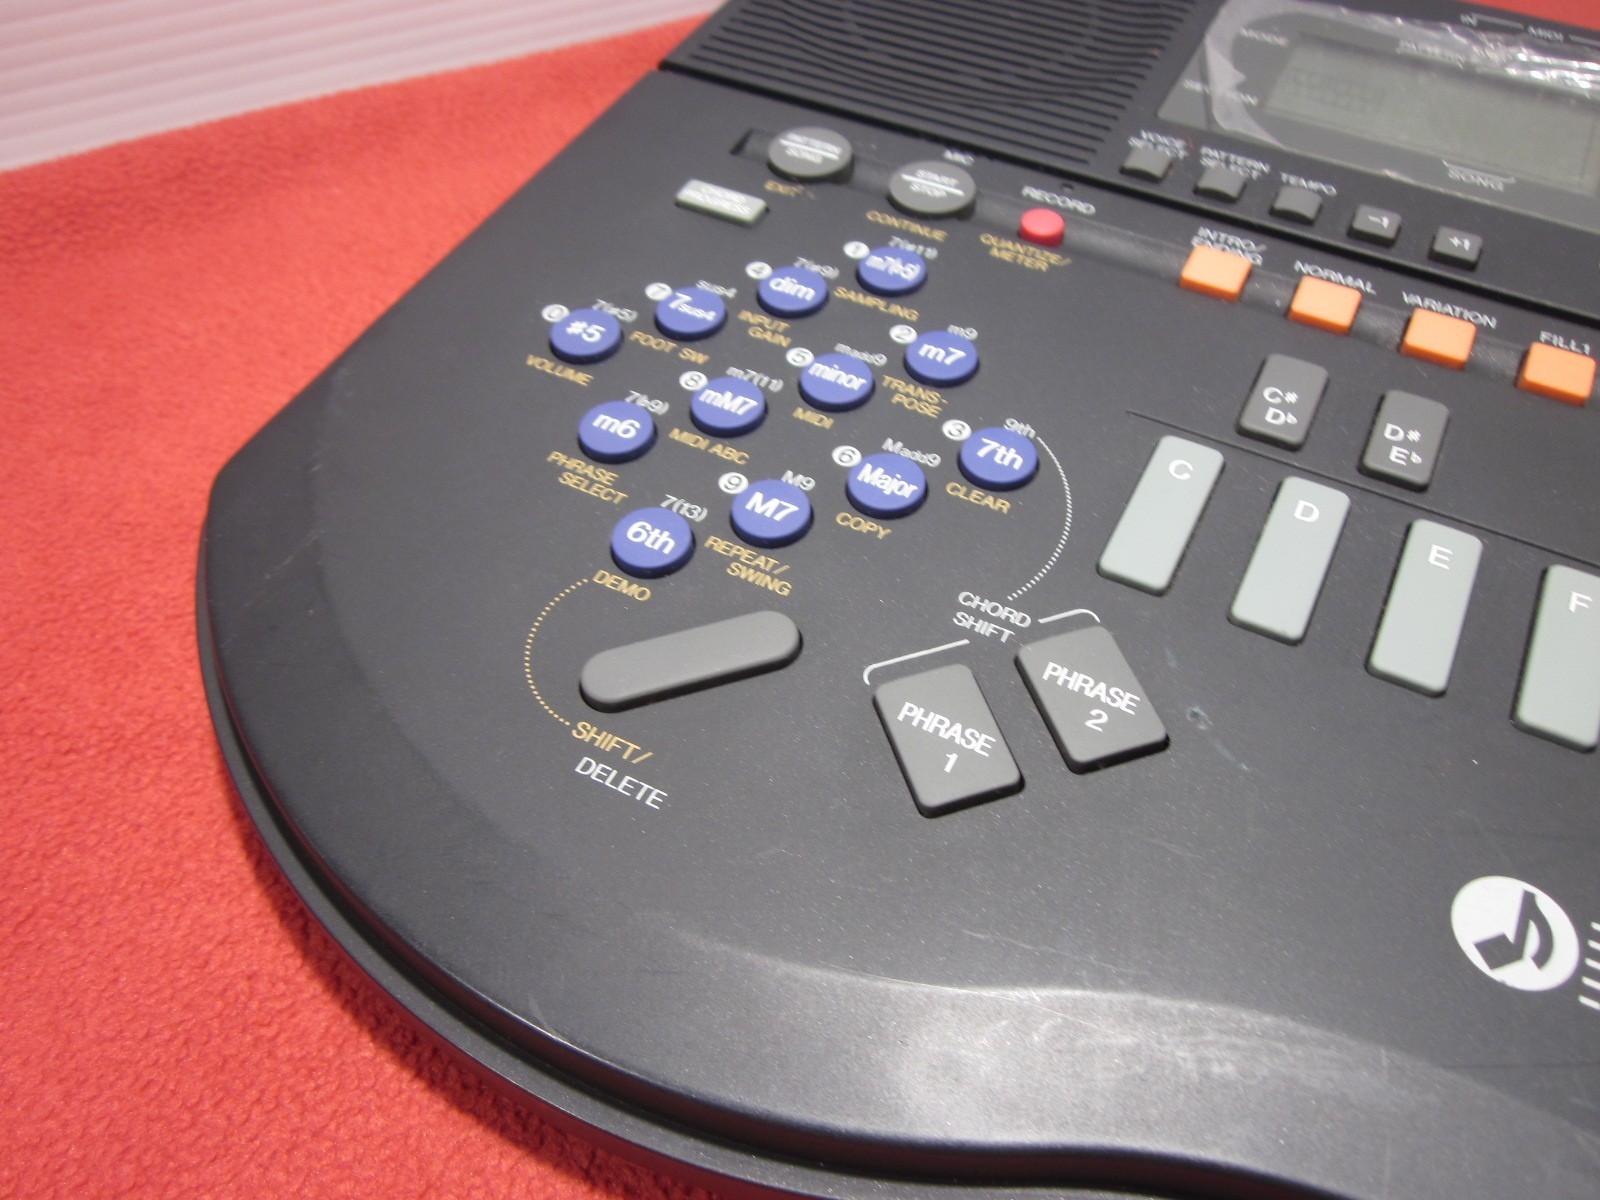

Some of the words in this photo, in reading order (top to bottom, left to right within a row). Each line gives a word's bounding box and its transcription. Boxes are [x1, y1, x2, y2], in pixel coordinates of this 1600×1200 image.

[1281, 171, 1338, 196] TEMPO
[1021, 185, 1096, 215] RECORD
[866, 210, 949, 242] CONTINUE
[769, 276, 816, 301] dim
[1294, 260, 1377, 296] NORMAL
[834, 286, 920, 322] SAMPLING
[1402, 291, 1497, 330] VARIATION
[566, 320, 607, 343] #5
[738, 309, 791, 333] INPUT
[629, 330, 677, 353] FOOT
[678, 347, 710, 365] SW
[748, 325, 792, 348] GAIN
[918, 343, 967, 366] m7
[526, 354, 594, 387] VOLUME
[808, 362, 868, 391] minor
[698, 388, 759, 416] mM7
[890, 392, 943, 419] POSE
[592, 412, 641, 440] m6
[792, 406, 835, 430] MIDI
[1003, 417, 1036, 439] 9th
[668, 427, 711, 450] MIDI
[708, 443, 750, 465] ABC
[976, 437, 1024, 471] 7th
[546, 450, 620, 486] PHRASE
[780, 469, 816, 492] M9
[856, 462, 918, 500] Major
[1167, 458, 1195, 481] C
[557, 471, 629, 505] SELECT
[945, 482, 1012, 514] CLEAR
[744, 491, 800, 522] M7
[1293, 499, 1321, 524] D
[625, 520, 676, 555] 6th
[835, 511, 892, 540] COPY
[1427, 543, 1454, 570] E
[592, 569, 652, 602] DEMO
[726, 561, 793, 597] SWING
[957, 591, 1033, 629] CHORD
[1568, 590, 1594, 614] F
[952, 611, 1016, 644] SHIFT
[1041, 661, 1142, 717] PHRASE
[897, 701, 997, 758] PHRASE
[1084, 708, 1110, 733] 2
[942, 752, 960, 774] 1
[574, 755, 669, 811] DELETE
